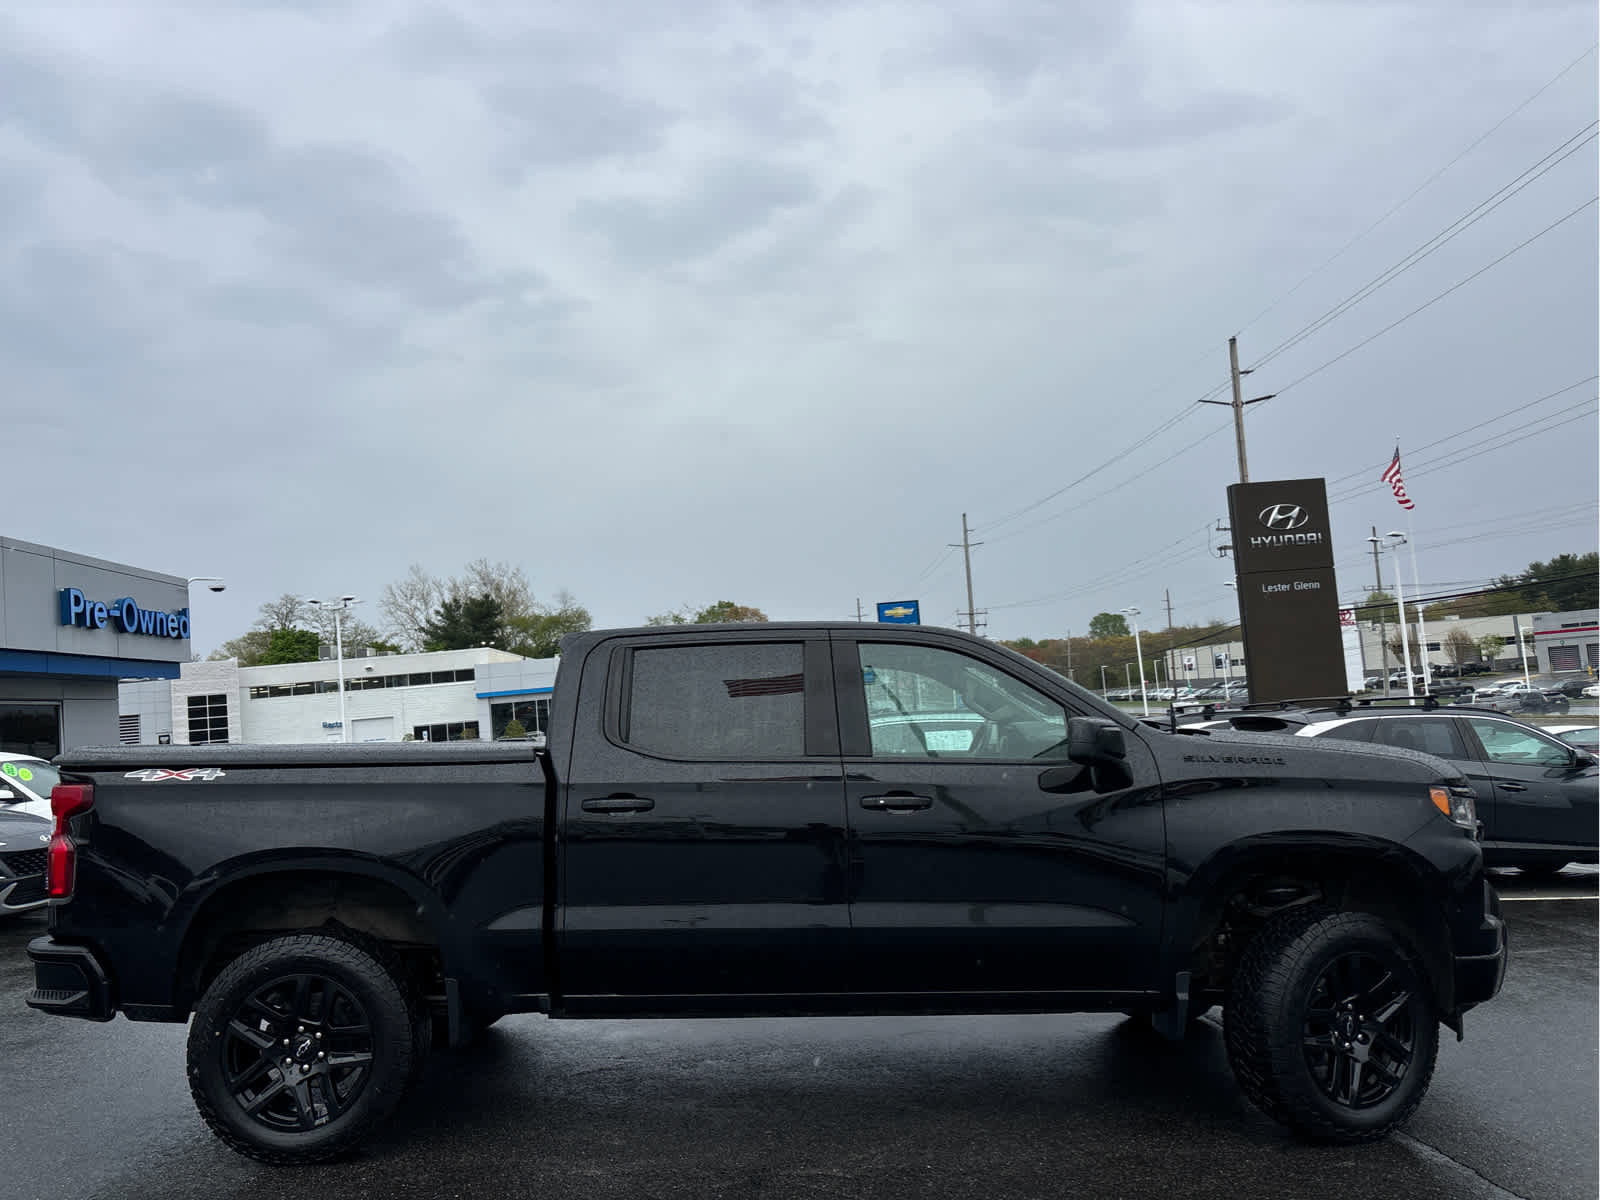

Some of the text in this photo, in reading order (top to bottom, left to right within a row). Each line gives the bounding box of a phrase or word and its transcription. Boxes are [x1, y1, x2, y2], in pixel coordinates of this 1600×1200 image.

[1250, 532, 1322, 548] HYUNDAI
[1262, 580, 1321, 593] Lester Glenn
[60, 587, 190, 640] Pre-Owned
[1183, 755, 1286, 765] SILVERADO
